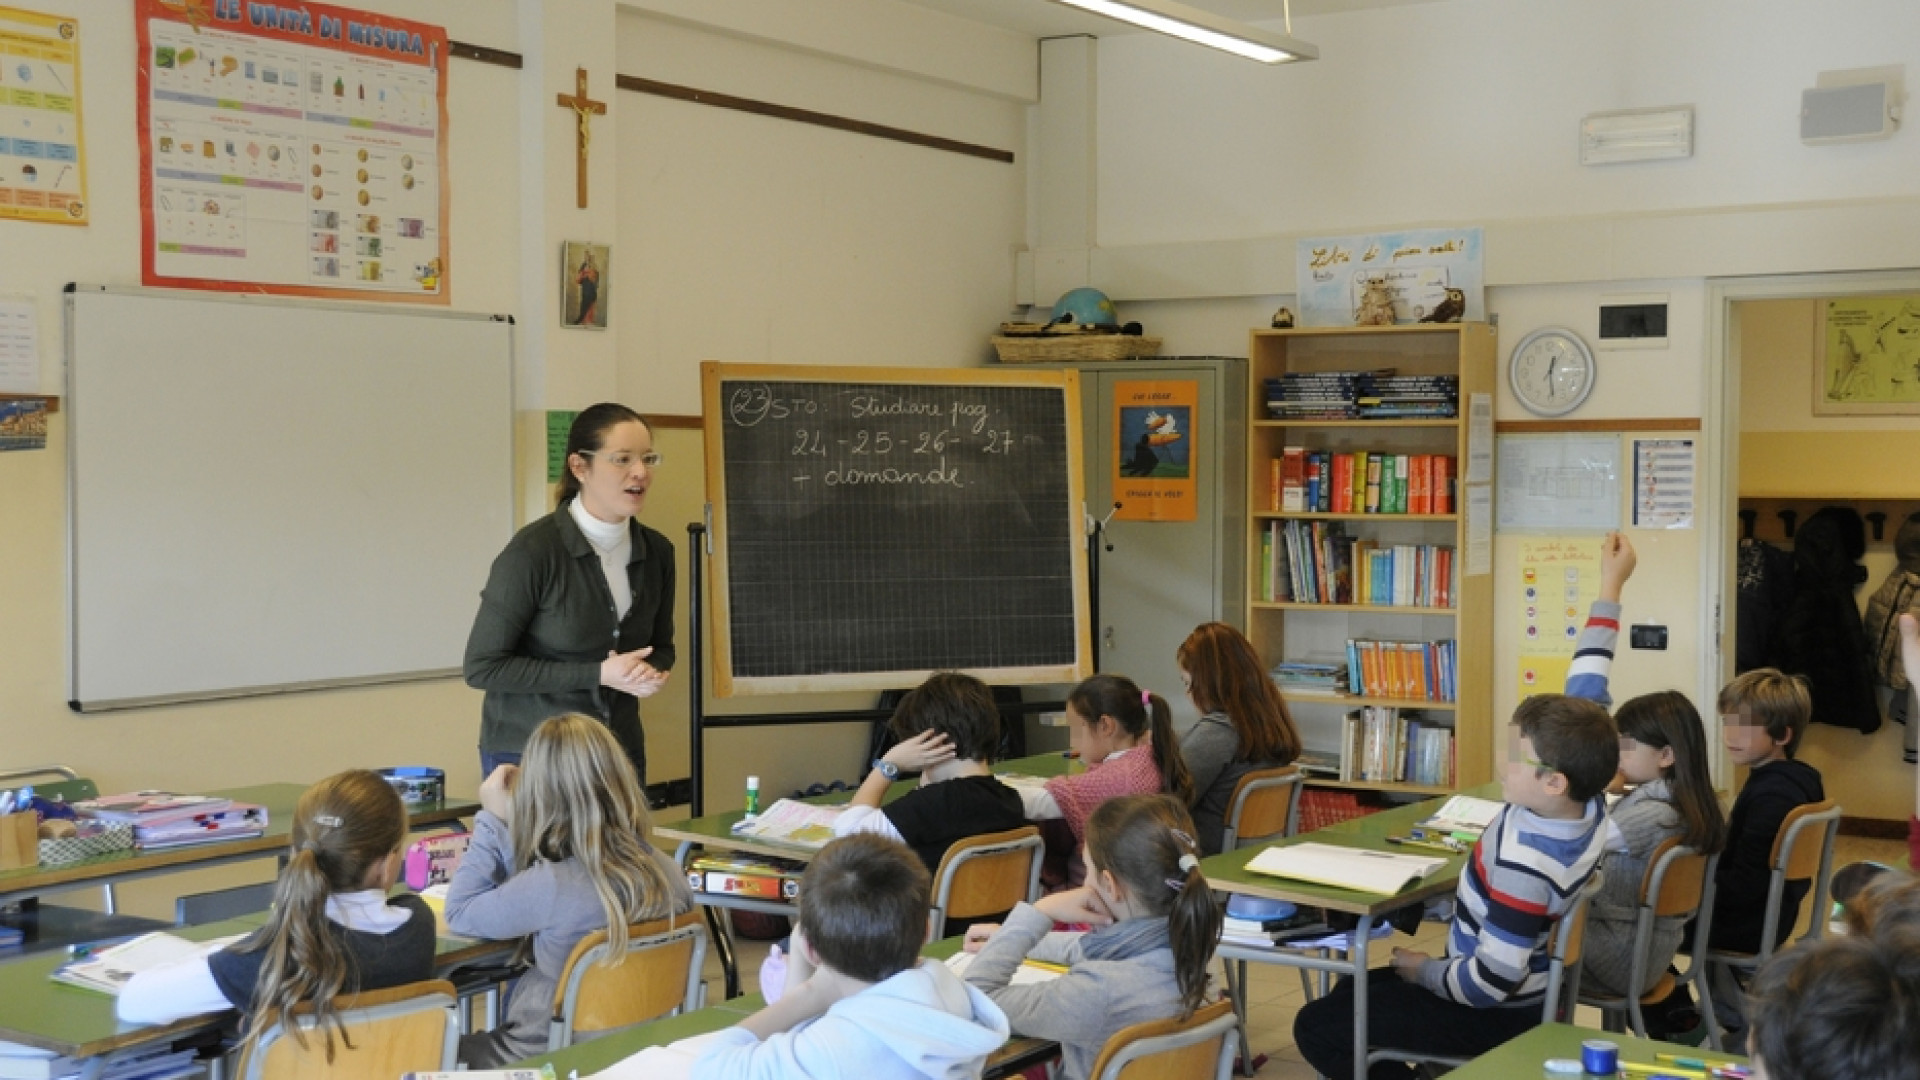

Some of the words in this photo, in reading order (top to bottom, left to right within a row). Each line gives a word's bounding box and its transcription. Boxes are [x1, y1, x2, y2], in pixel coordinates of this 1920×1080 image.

[214, 0, 241, 21] LE
[249, 3, 313, 35] UNITÀ
[319, 14, 341, 40] DI
[348, 21, 425, 56] MISURA
[850, 395, 944, 419] Studiare
[790, 429, 827, 455] 24
[851, 429, 894, 454] 25
[912, 429, 950, 454] 26
[982, 428, 1015, 455] 27
